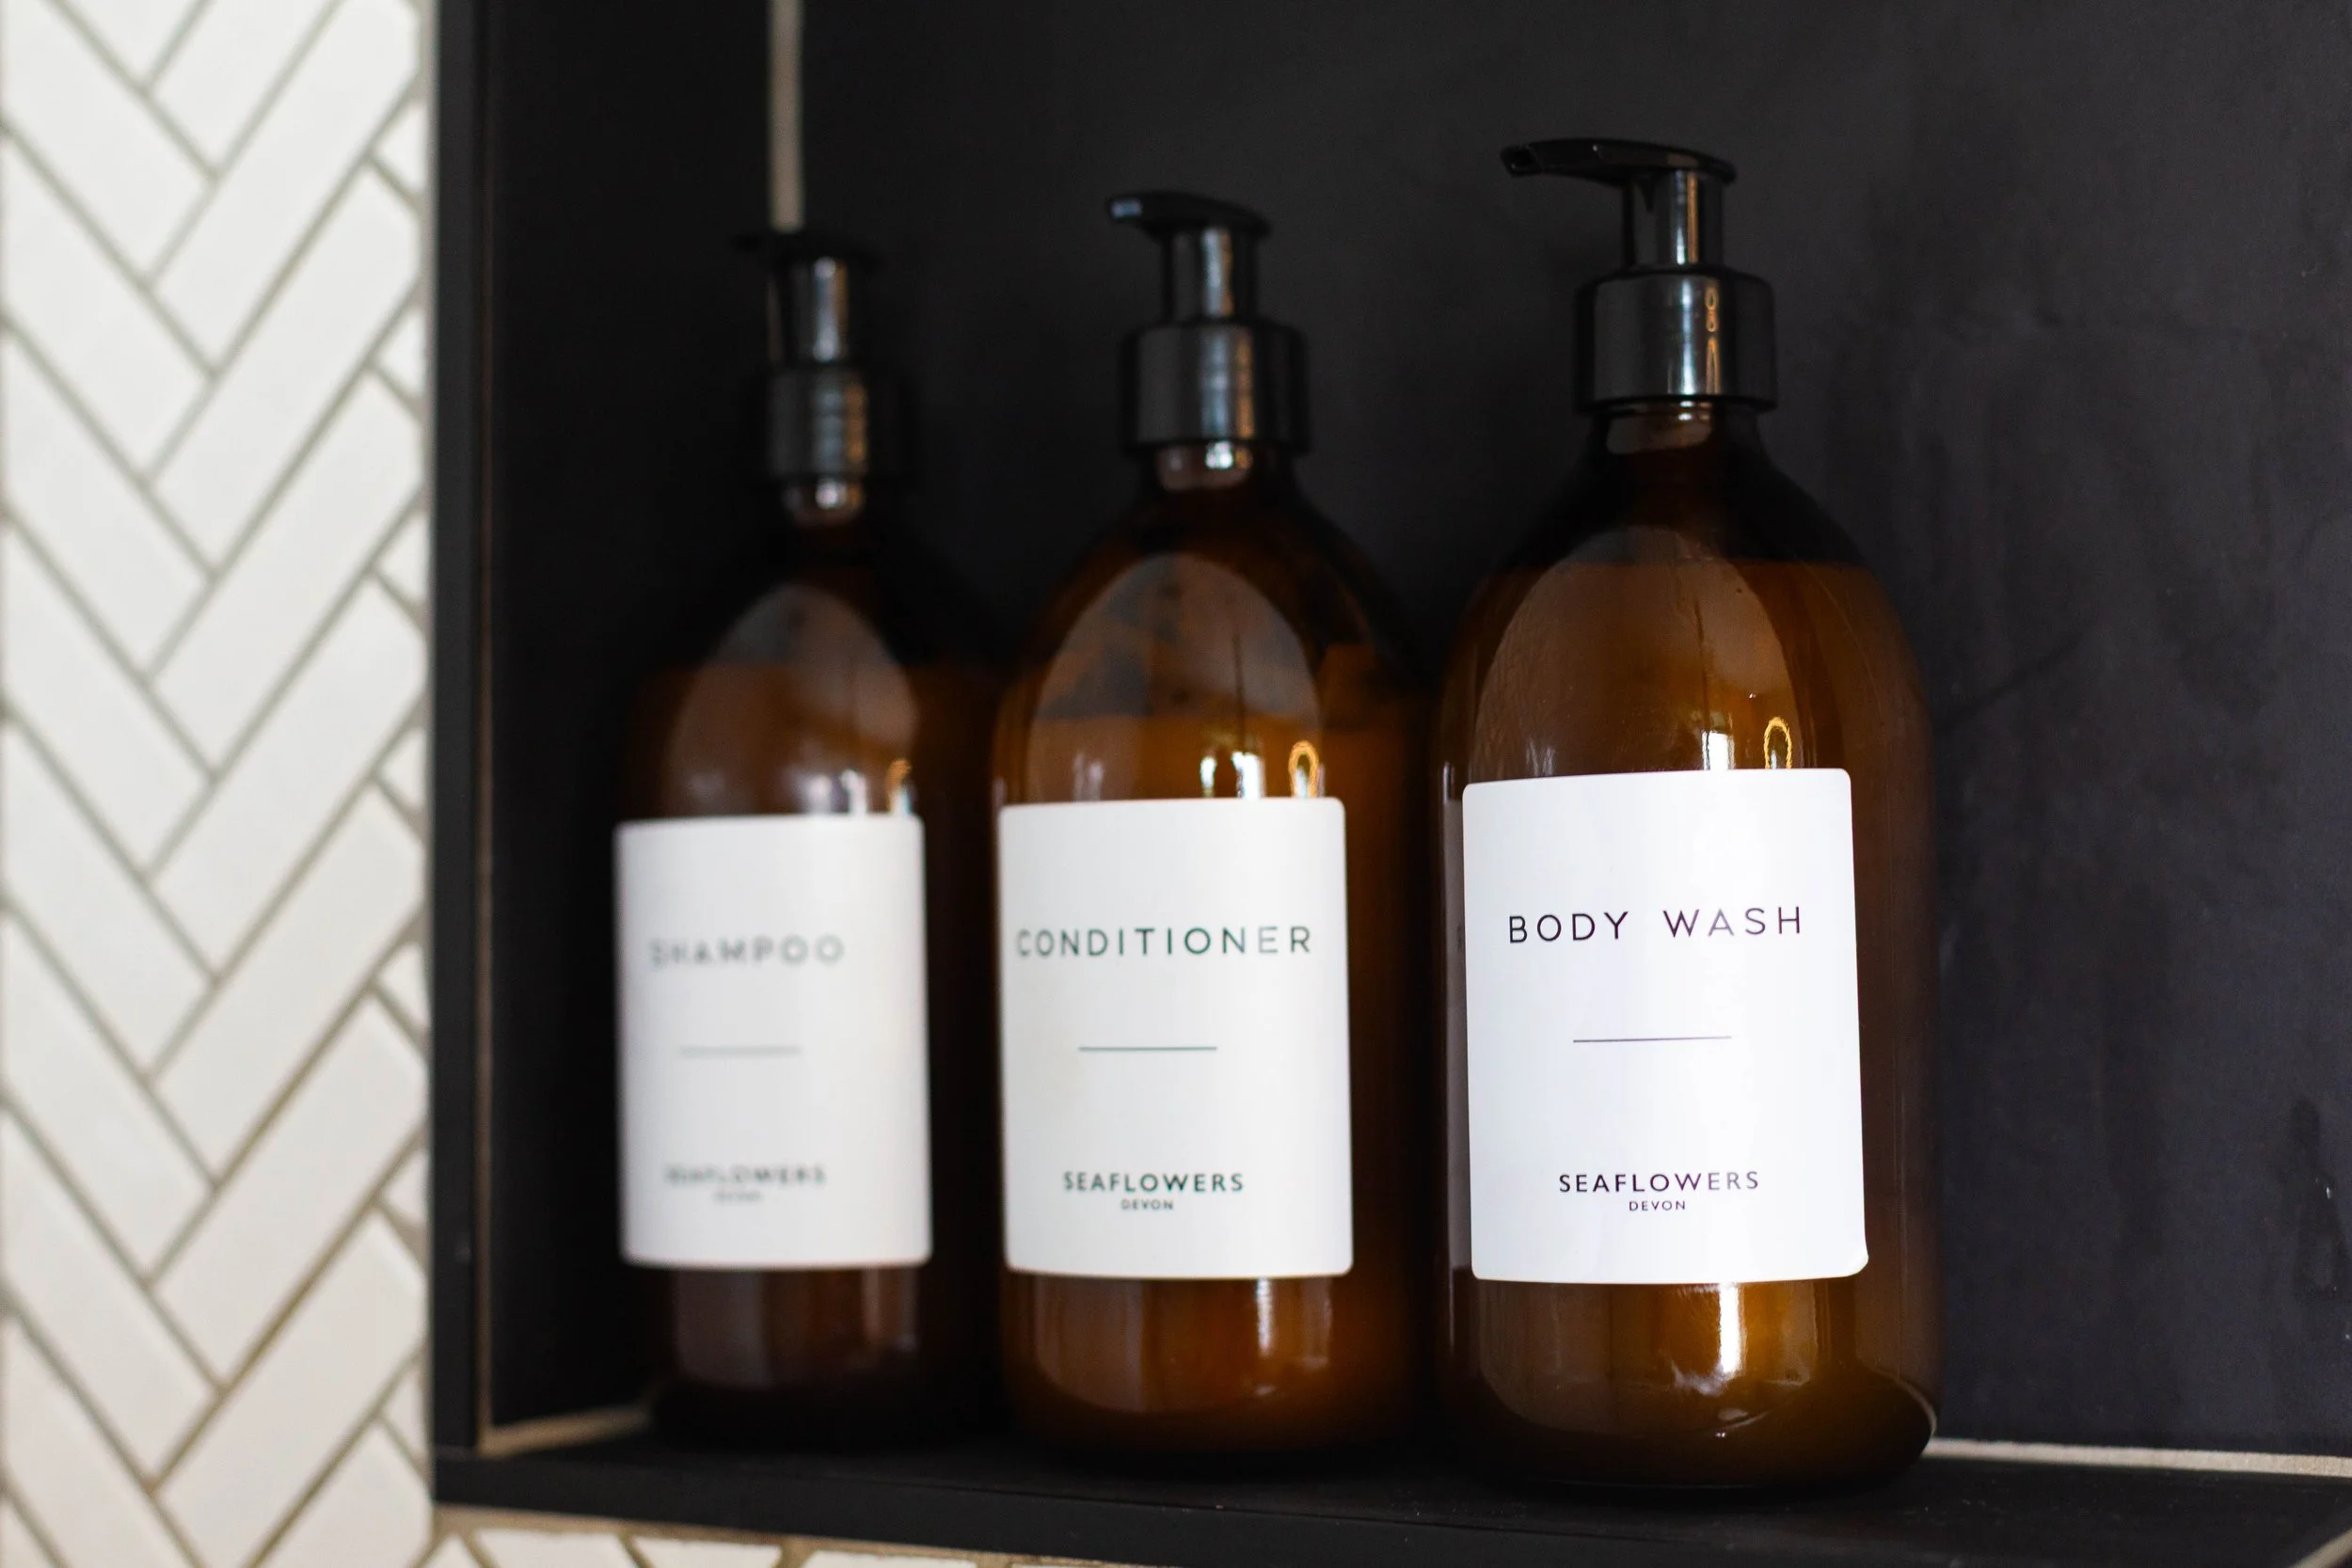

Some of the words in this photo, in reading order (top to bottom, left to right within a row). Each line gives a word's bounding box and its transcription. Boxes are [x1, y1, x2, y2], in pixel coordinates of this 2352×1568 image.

[1508, 911, 1629, 944] BODY
[1662, 906, 1802, 939] WASH
[1016, 926, 1311, 957] CONDITIONER
[1063, 1172, 1245, 1193] SEAFLOWERS
[1559, 1171, 1759, 1193] SEAFLOWERS
[1120, 1198, 1175, 1211] DEVON
[1629, 1200, 1687, 1212] DEVON
